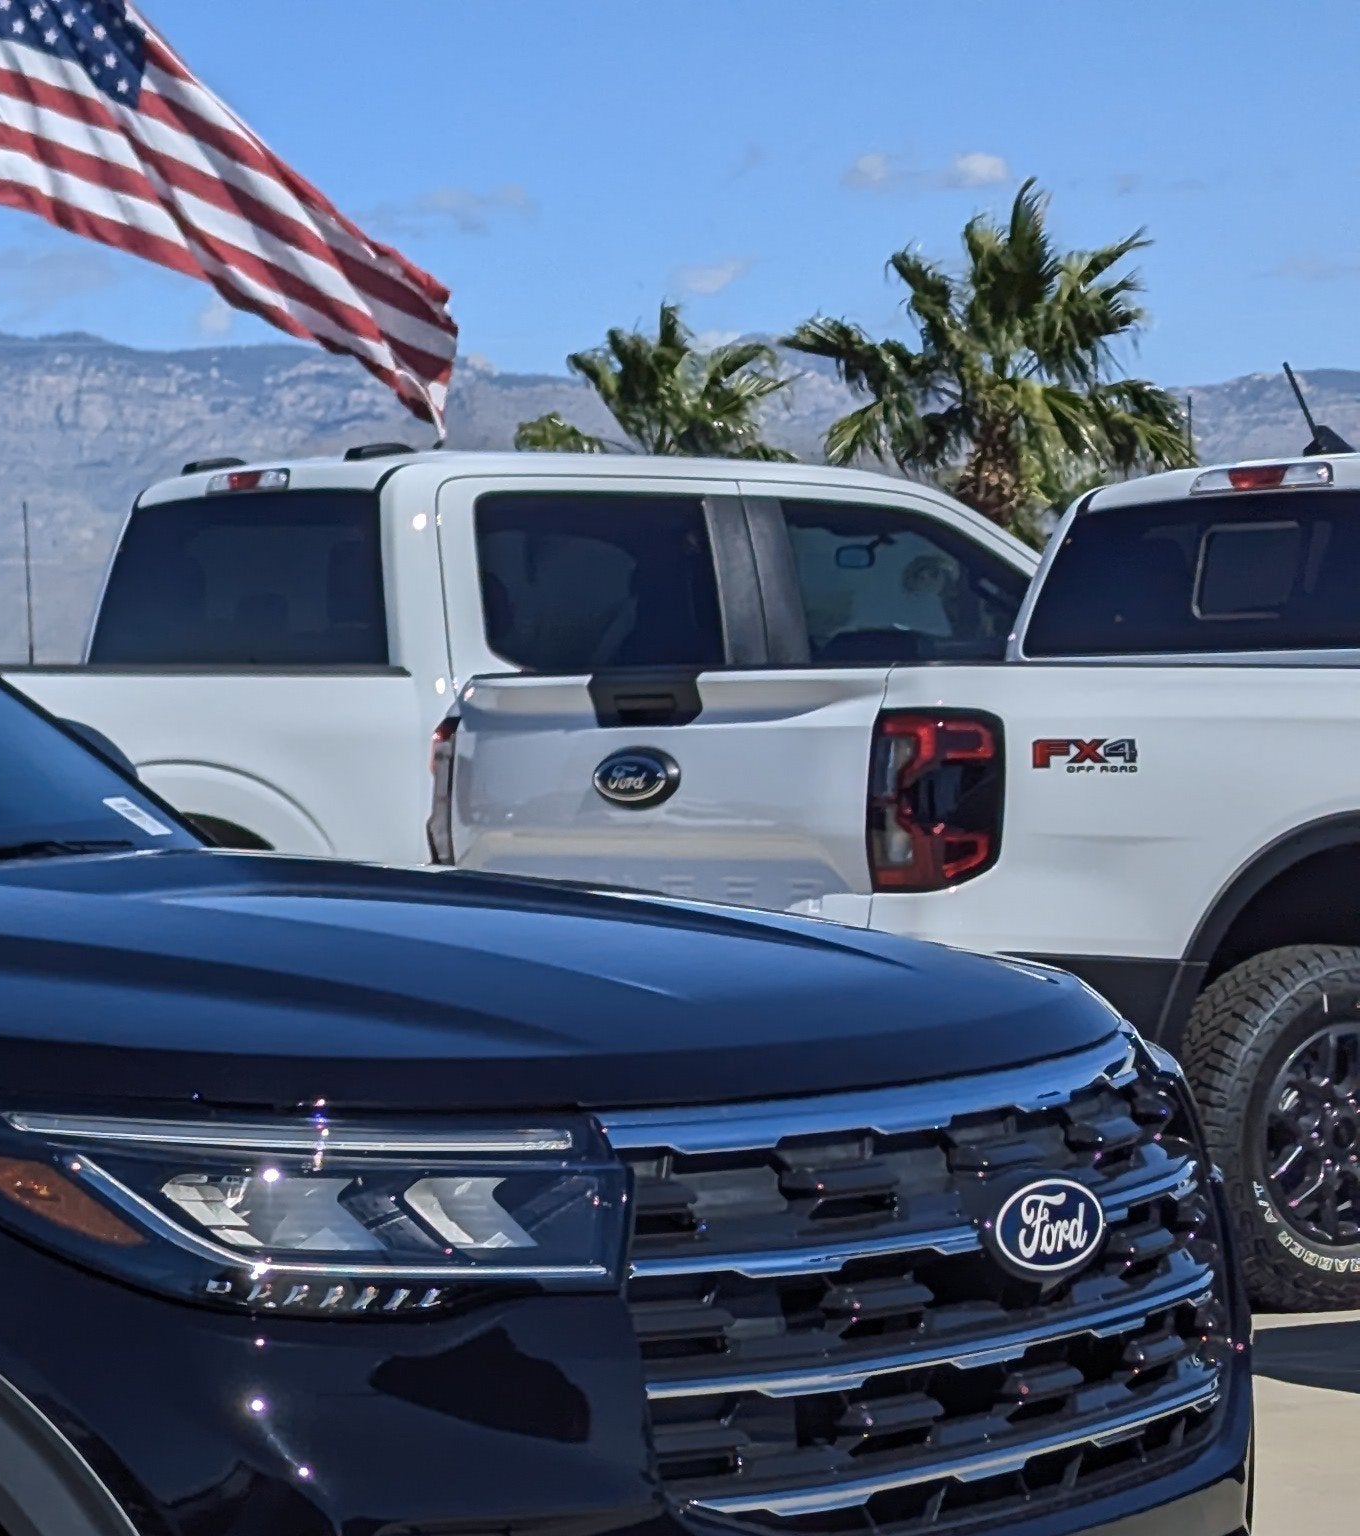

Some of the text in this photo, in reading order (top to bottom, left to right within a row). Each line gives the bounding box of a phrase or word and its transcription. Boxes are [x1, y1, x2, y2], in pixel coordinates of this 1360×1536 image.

[1032, 738, 1138, 769] FX4
[607, 765, 647, 790] Ford
[1066, 765, 1138, 774] OFF ROAD
[1018, 1191, 1088, 1259] Ford
